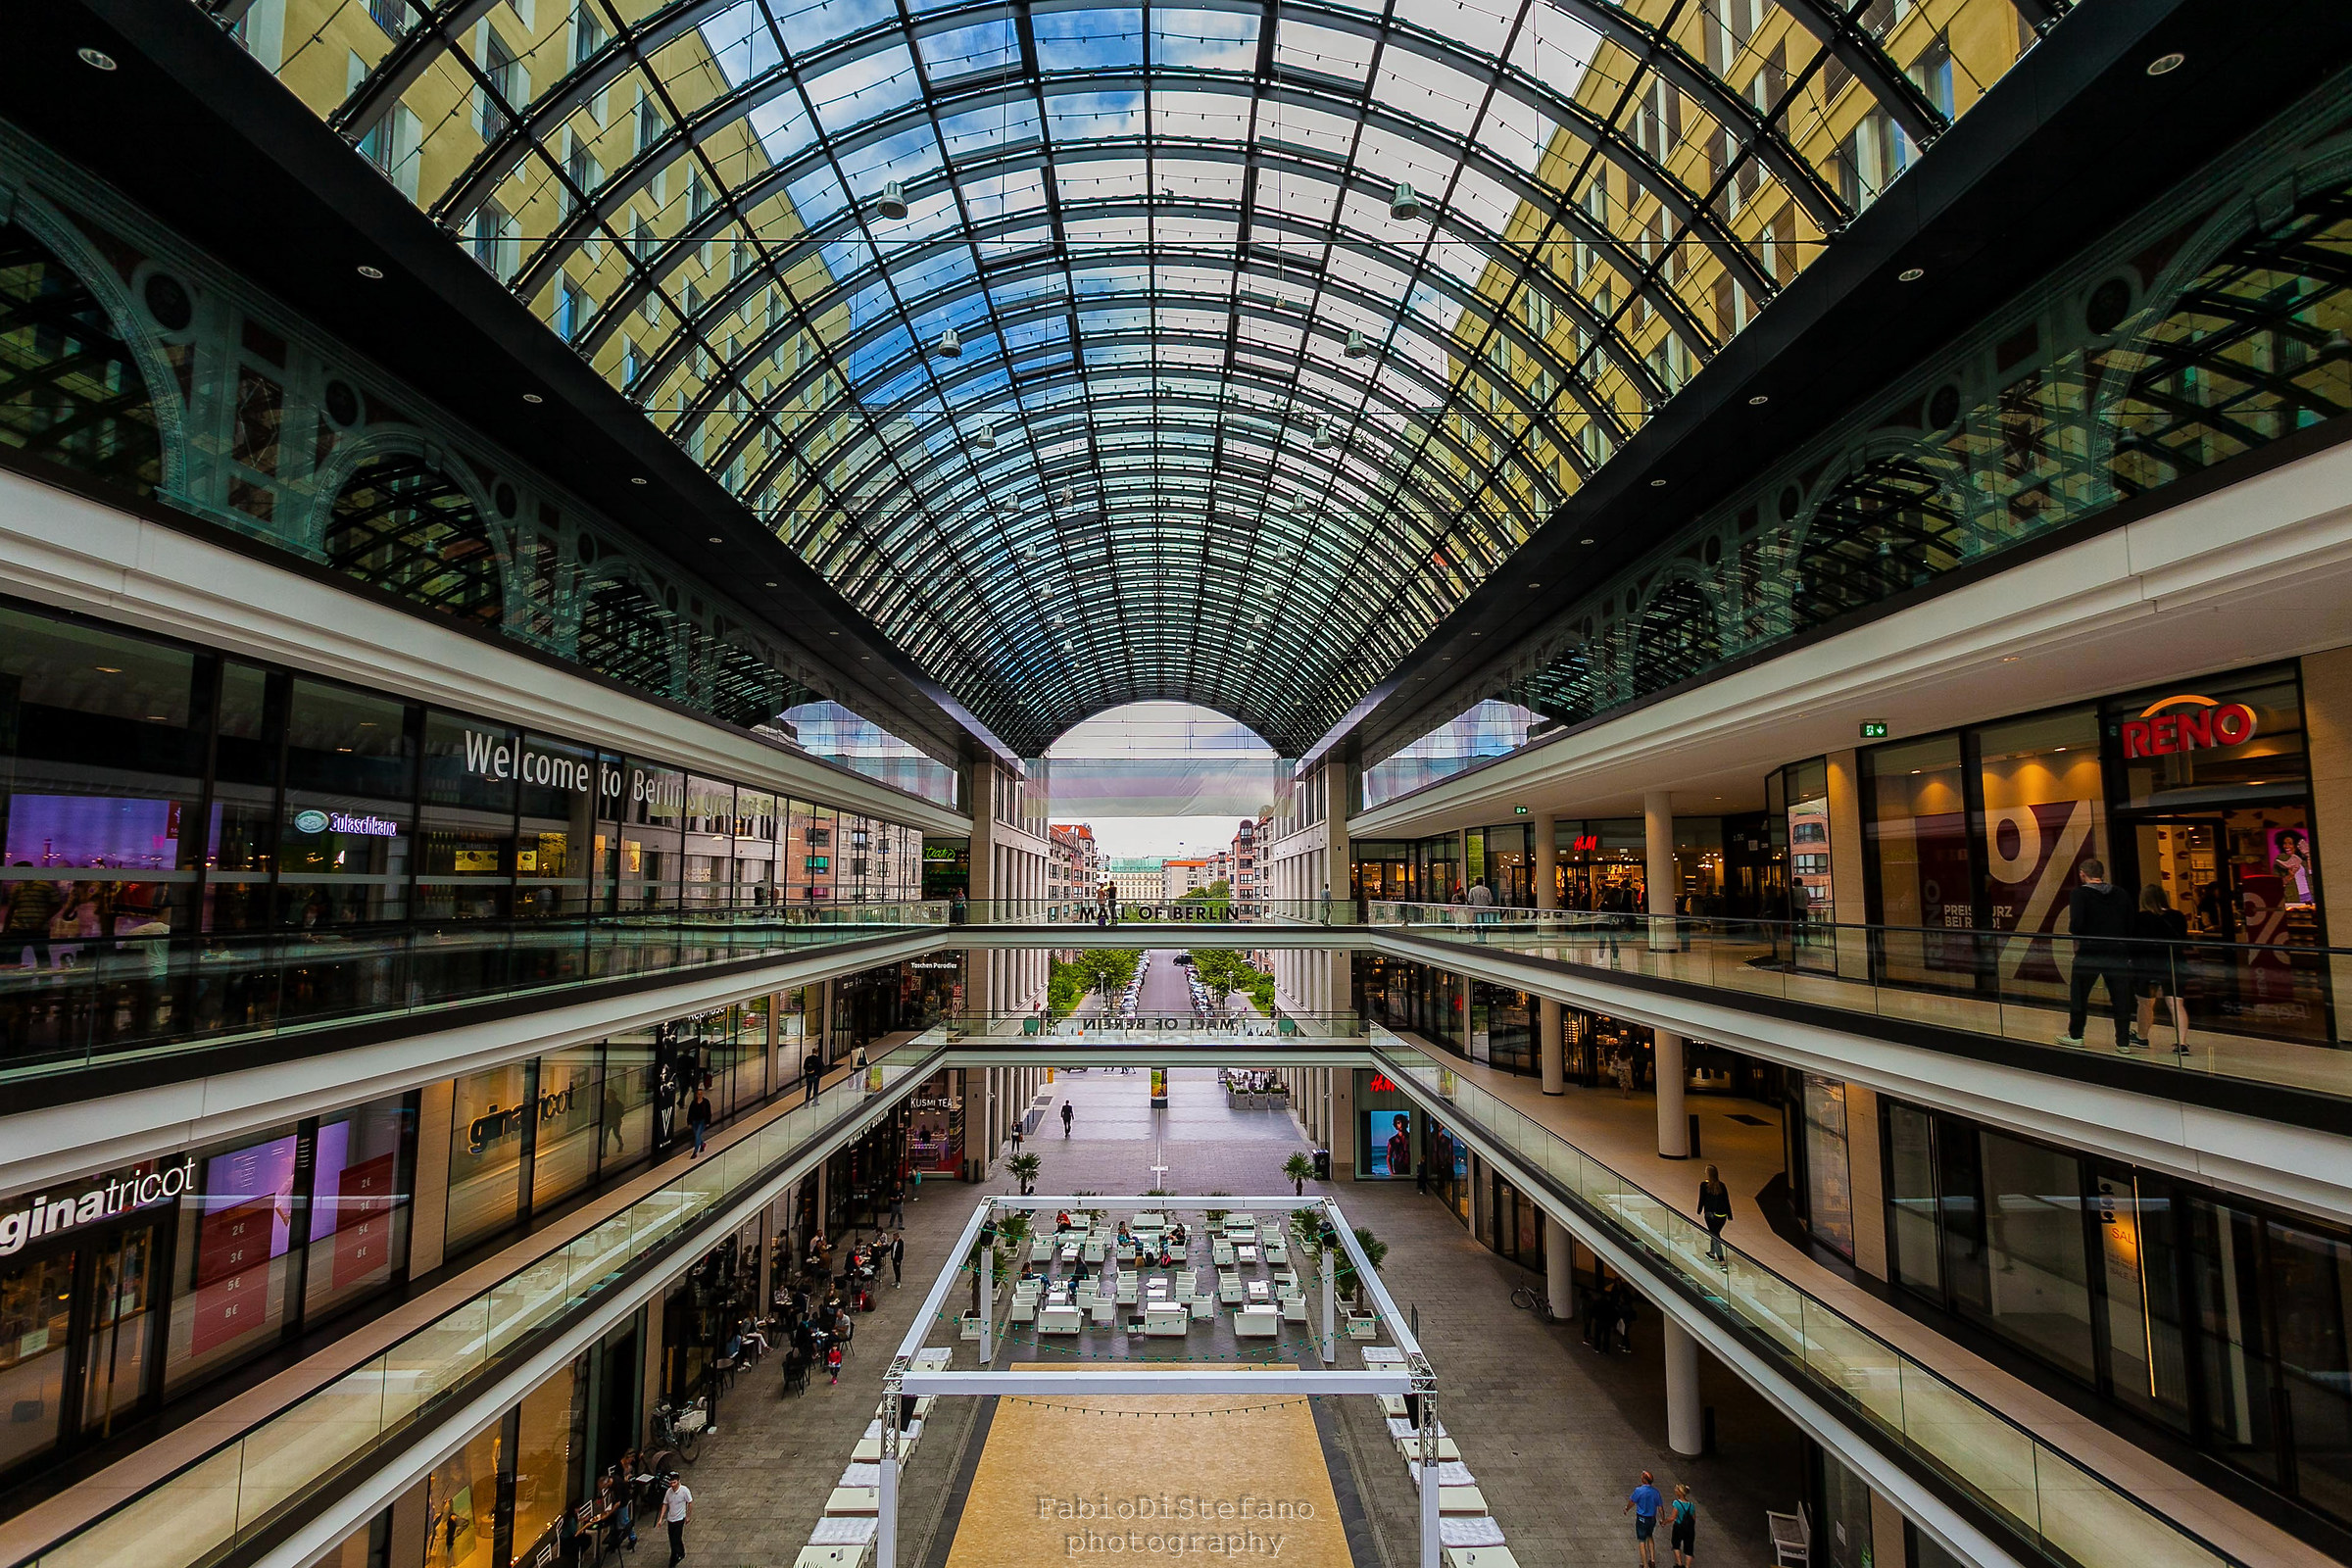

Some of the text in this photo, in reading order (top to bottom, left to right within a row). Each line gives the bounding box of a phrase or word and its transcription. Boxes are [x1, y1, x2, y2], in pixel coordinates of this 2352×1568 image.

[2122, 703, 2257, 759] RENO
[465, 729, 589, 792] Welcome
[601, 762, 621, 798] to
[633, 769, 696, 810] Berlin's
[1573, 835, 1597, 851] H&M
[1079, 906, 1240, 920] MALL OF BERLIN
[1944, 916, 1962, 928] BEI
[910, 1097, 953, 1108] KUSMI TEA
[0, 1156, 196, 1256] ginatricot
[231, 1222, 245, 1236] 2€
[359, 1223, 368, 1235] 5€
[2111, 1227, 2134, 1245] SAL
[230, 1250, 243, 1263] 3€
[227, 1277, 241, 1292] 5€
[224, 1303, 239, 1318] 8€
